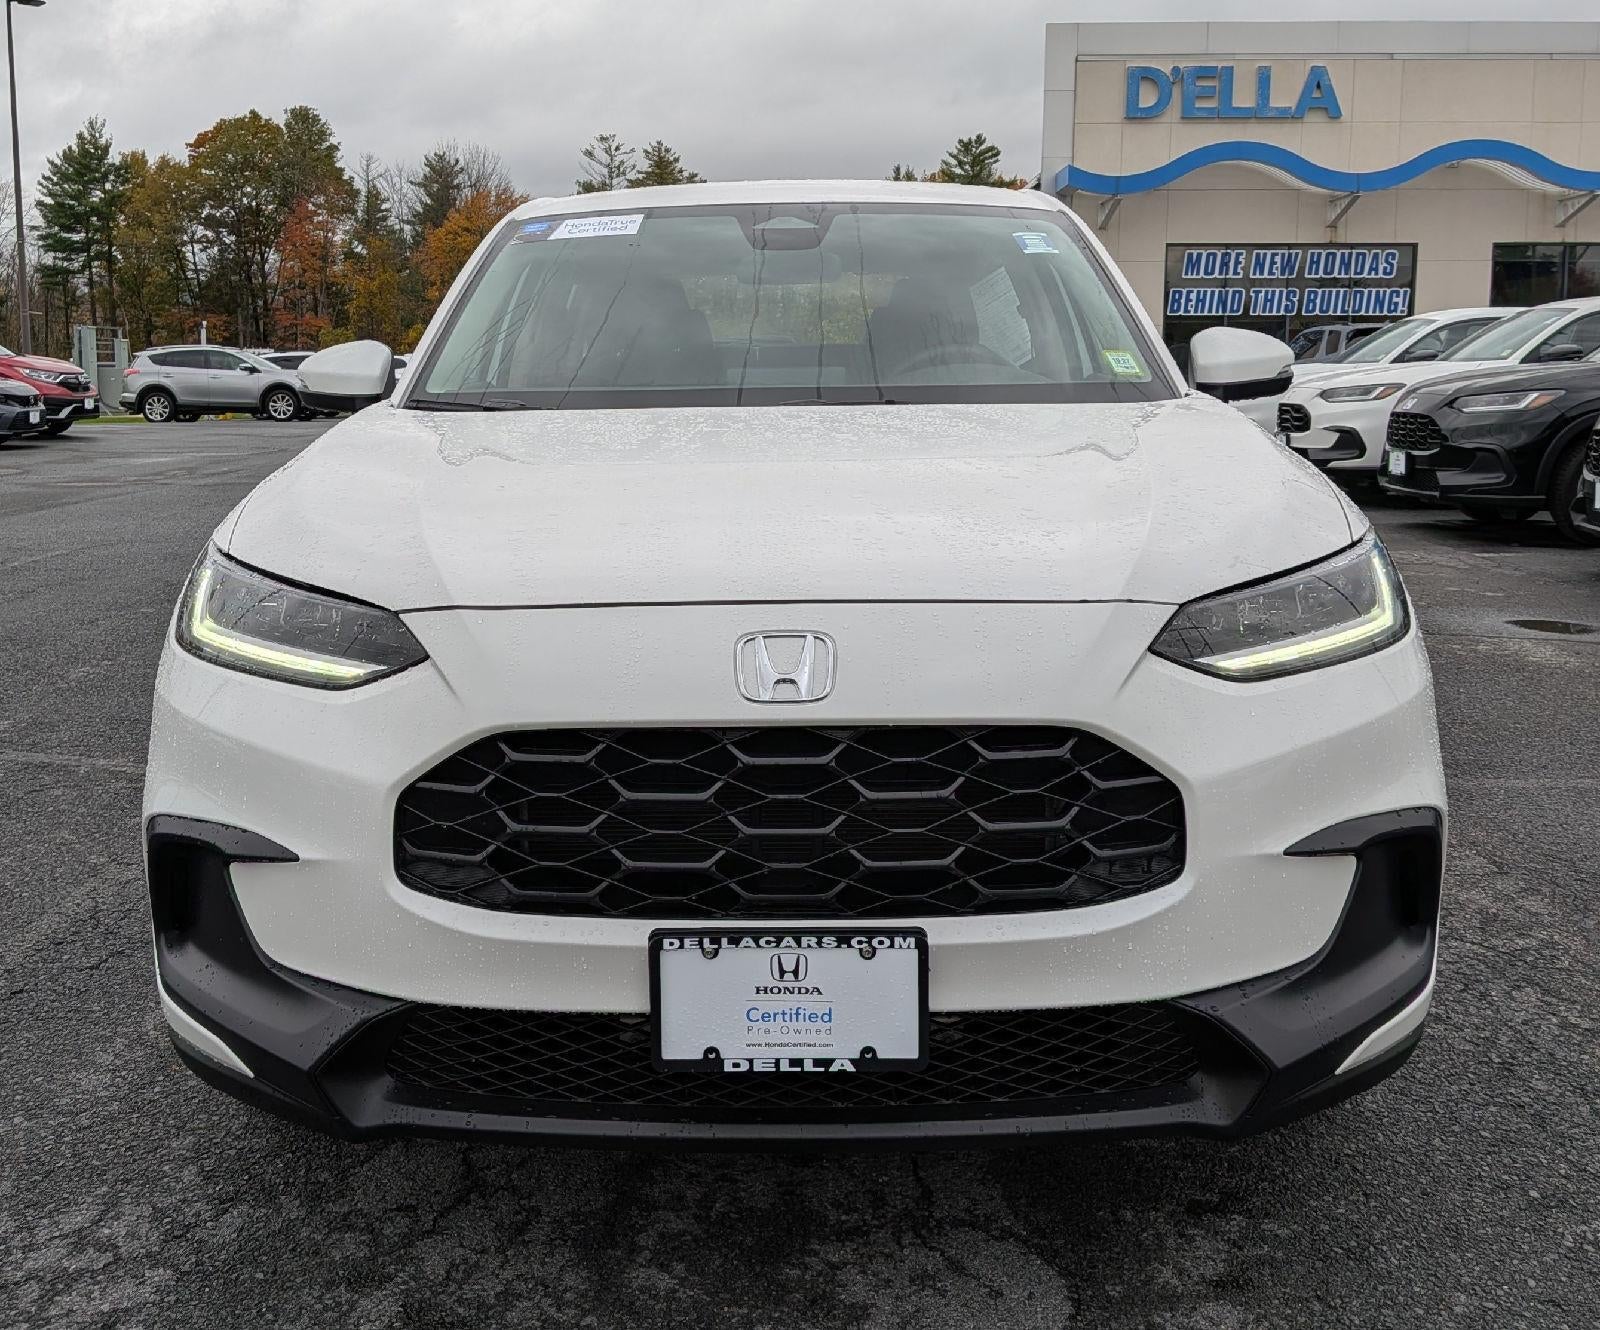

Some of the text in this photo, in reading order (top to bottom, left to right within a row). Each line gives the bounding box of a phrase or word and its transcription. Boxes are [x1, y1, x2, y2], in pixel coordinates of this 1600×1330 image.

[564, 219, 637, 229] HondaTrue
[567, 225, 628, 234] Certified
[1182, 250, 1399, 278] MORE NEW HONDAS
[1167, 288, 1410, 316] BEHIND THIS BUILDING!
[662, 936, 916, 950] DELLACARS.COM
[754, 985, 824, 996] HONDA
[745, 1006, 833, 1024] Certified
[746, 1025, 832, 1036] Pre-Owned
[745, 1041, 834, 1049] www.HondaCertified.com
[723, 1058, 856, 1072] DELLA
